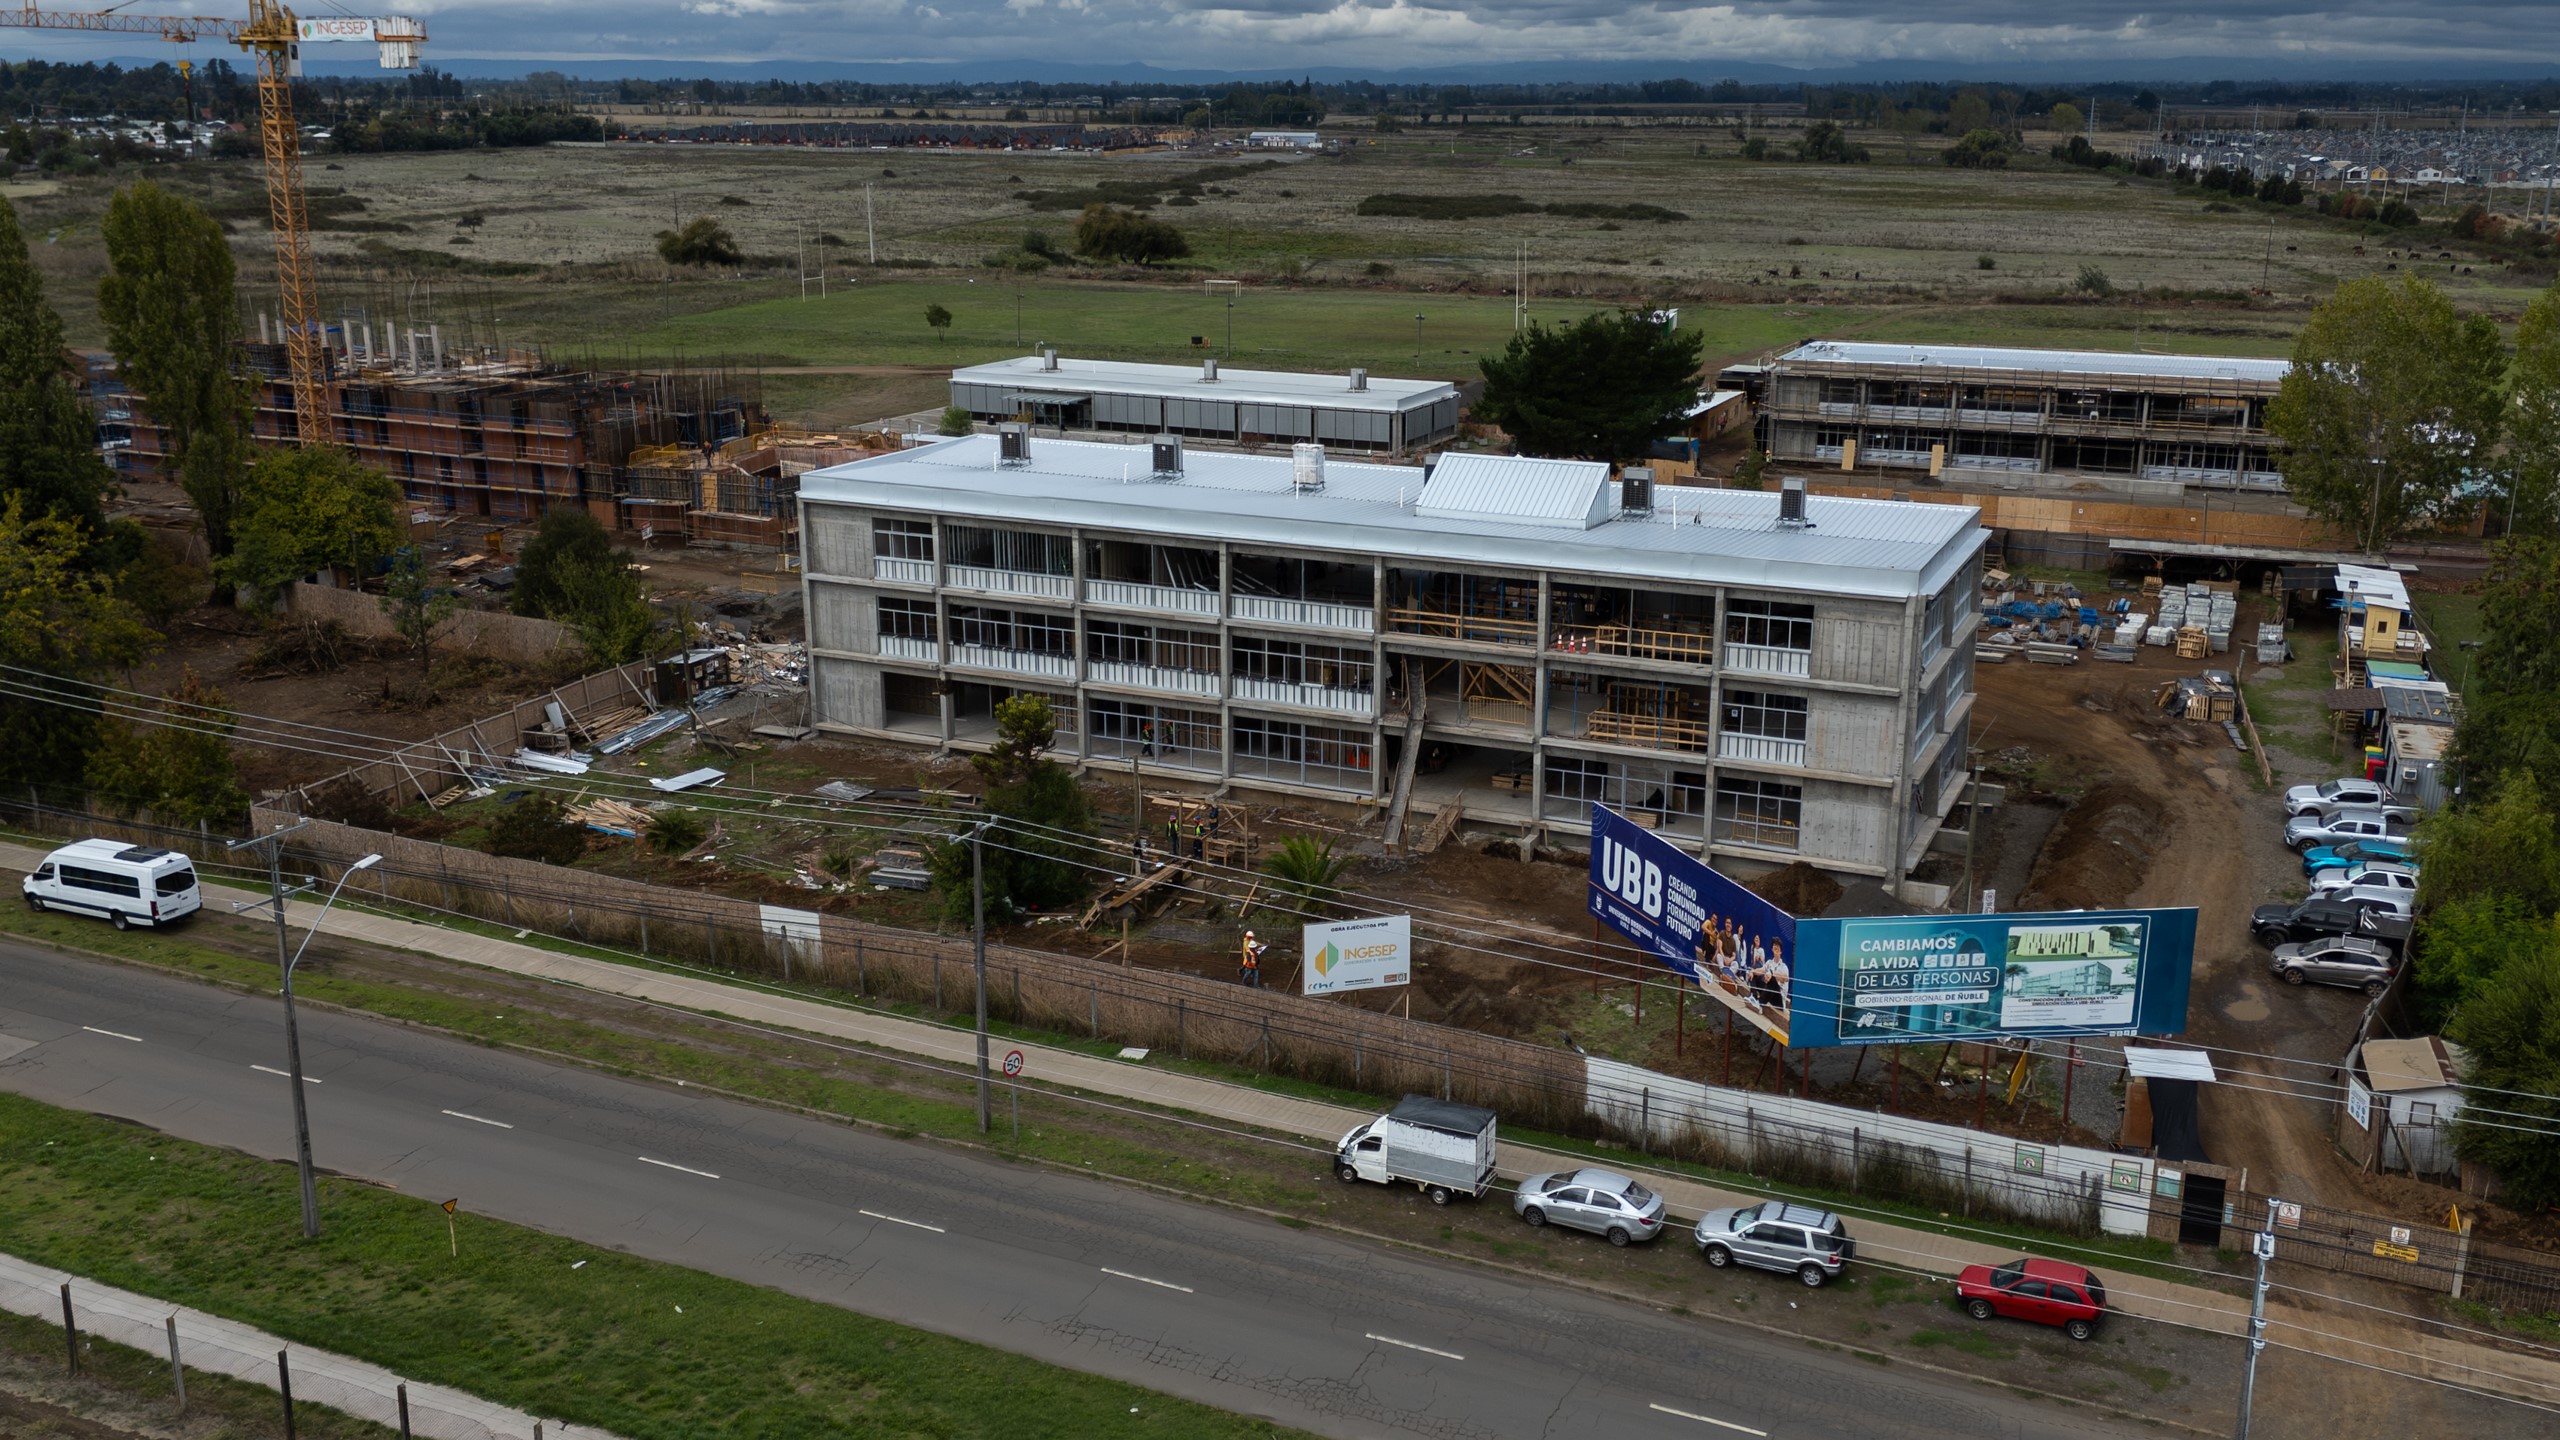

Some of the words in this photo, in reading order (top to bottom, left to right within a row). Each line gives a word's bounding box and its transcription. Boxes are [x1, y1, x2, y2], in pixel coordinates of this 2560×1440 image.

[316, 21, 368, 34] INGESEP
[1602, 835, 1662, 918] UBB
[1668, 874, 1697, 901] CREANDO
[1667, 889, 1705, 920] COMUNIDAD
[1667, 901, 1700, 932] FORMANDO
[1666, 915, 1692, 940] FUTURO
[1344, 944, 1397, 960] INGESEP
[1860, 937, 1956, 952] CAMBIAMOS
[1859, 957, 1879, 969] LA
[1882, 956, 1919, 969] VIDA
[1858, 975, 1878, 987] DE
[1882, 974, 1908, 986] LAS
[1913, 971, 1991, 985] PERSONAS
[1859, 994, 1901, 1004] GOBIERNO
[1903, 994, 1942, 1002] REGIONAL
[1958, 991, 1984, 1000] ÑUBLE
[1007, 1057, 1020, 1071] 50
